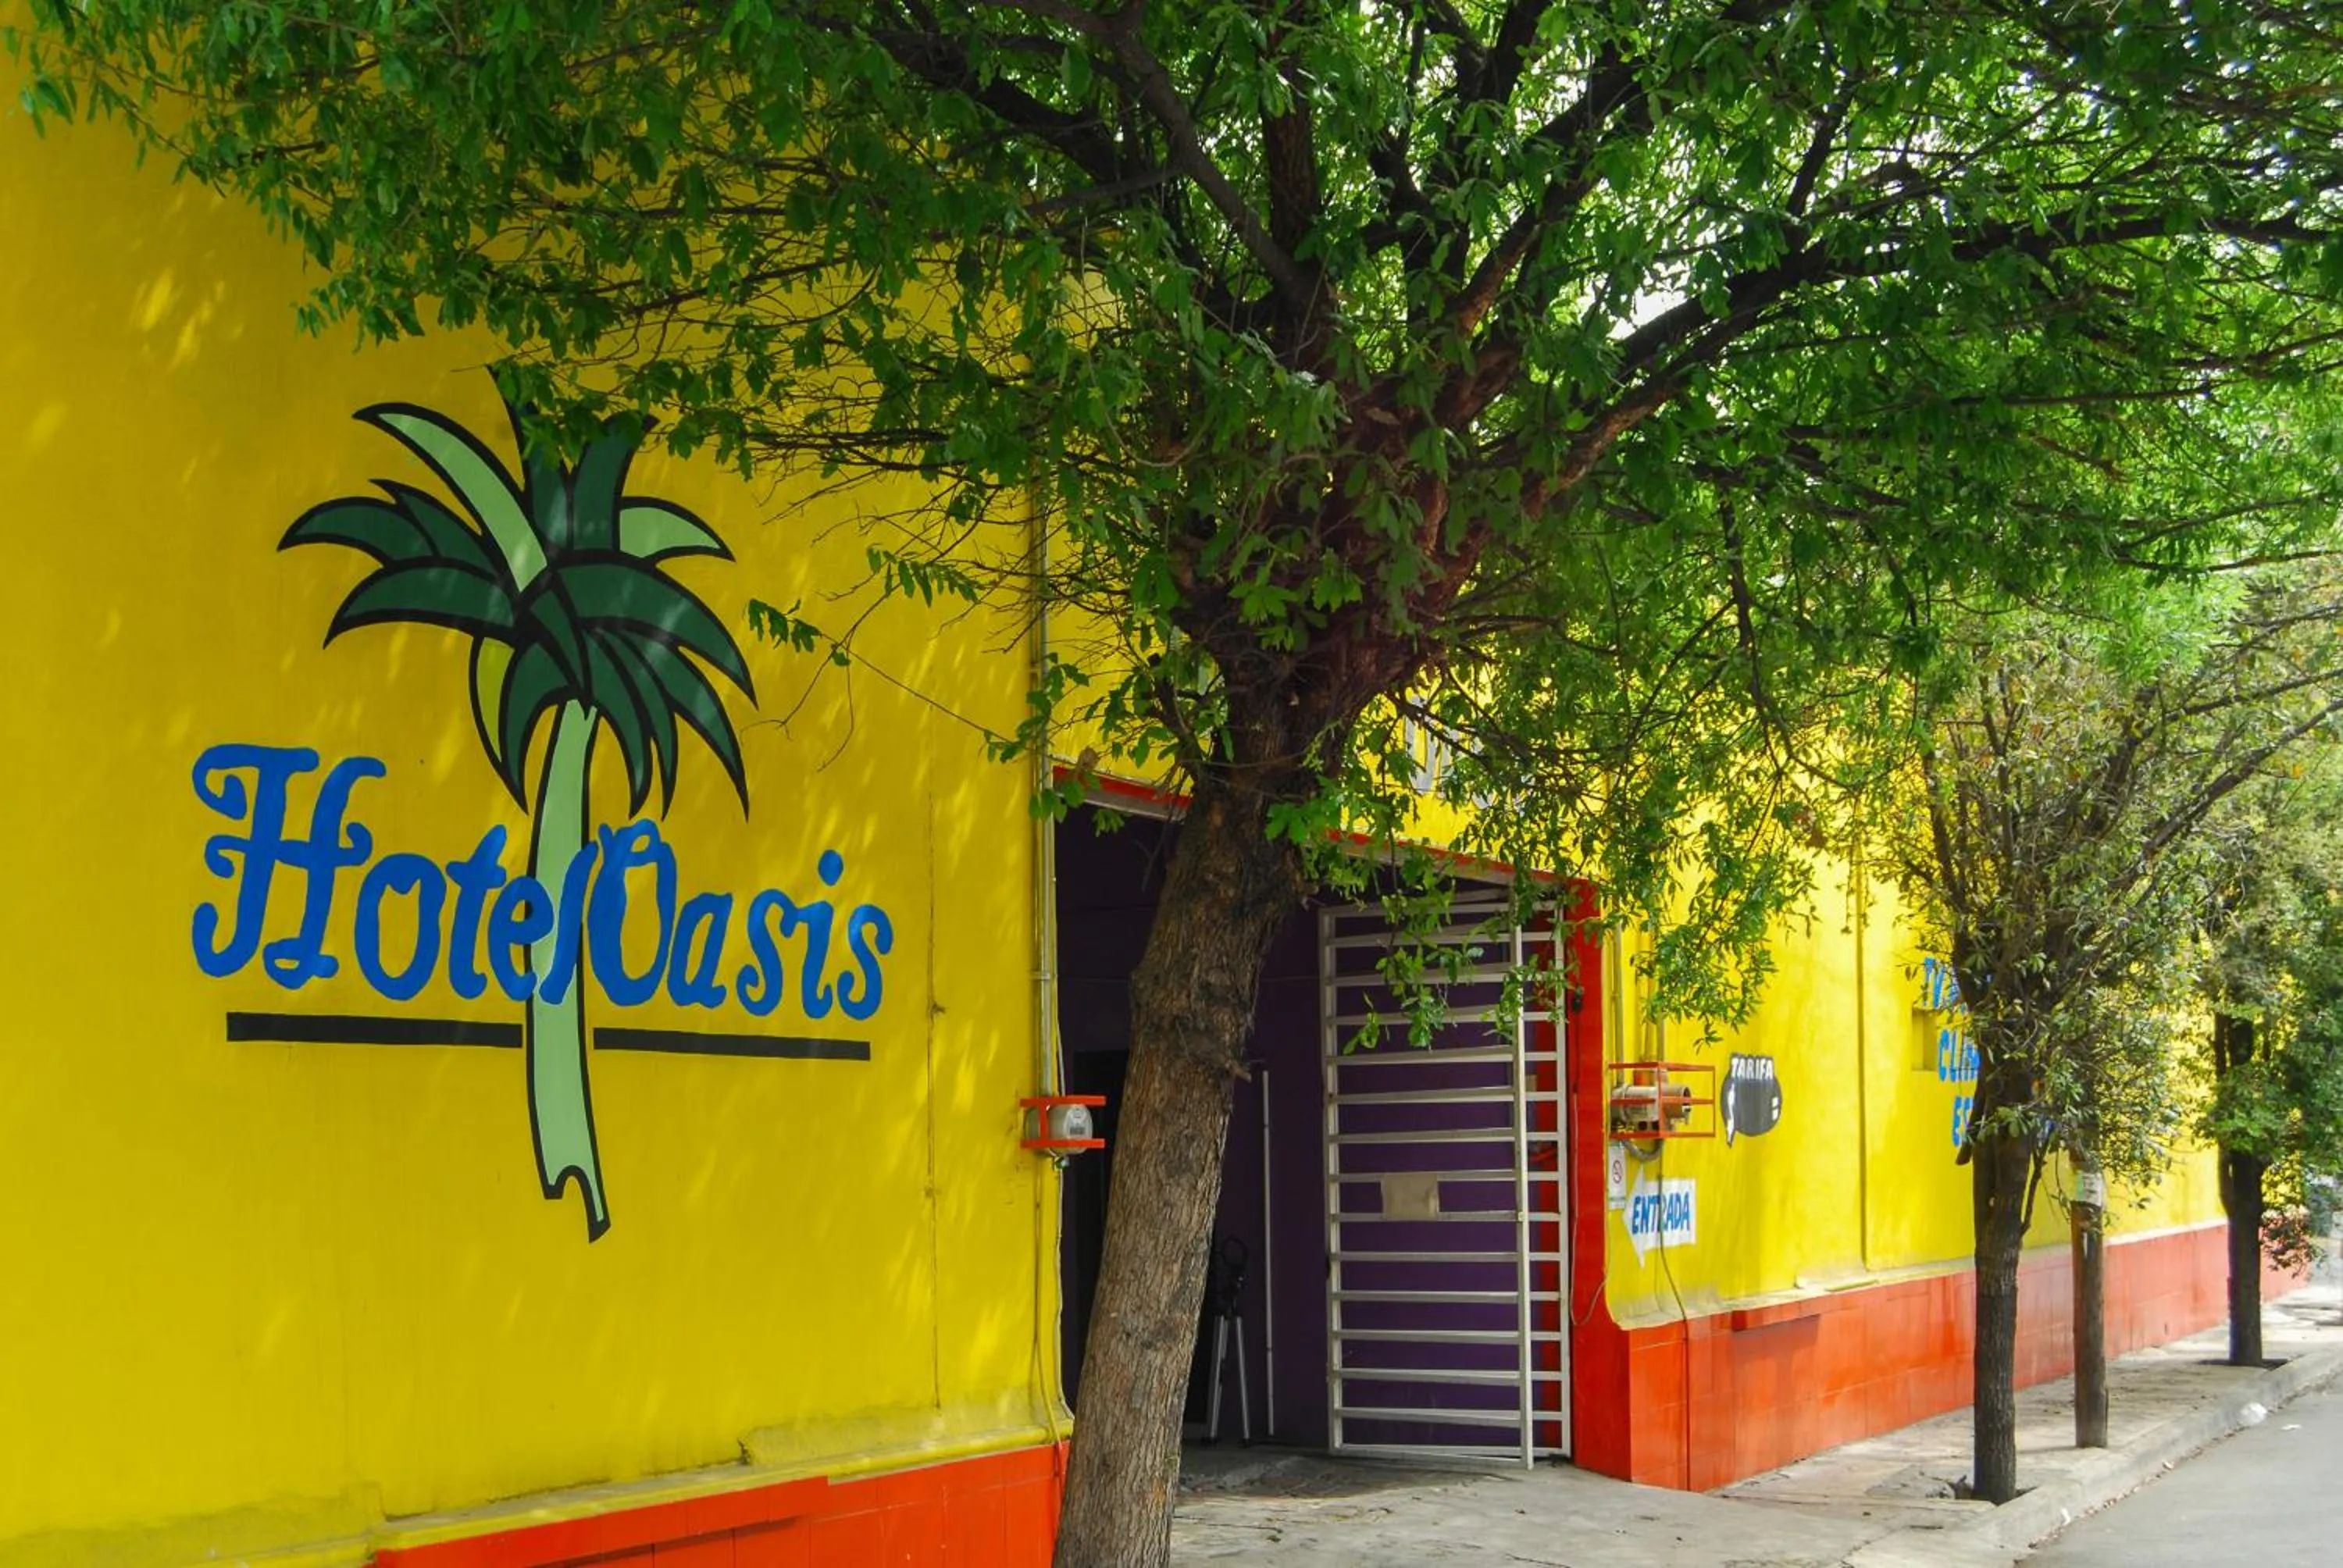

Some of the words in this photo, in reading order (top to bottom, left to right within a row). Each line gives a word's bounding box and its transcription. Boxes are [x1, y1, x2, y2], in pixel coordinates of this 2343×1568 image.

[192, 743, 597, 1005] Hotel
[586, 818, 894, 1021] Oasis
[1731, 1057, 1774, 1082] TARIFA
[1632, 1192, 1691, 1235] ENTRADA
